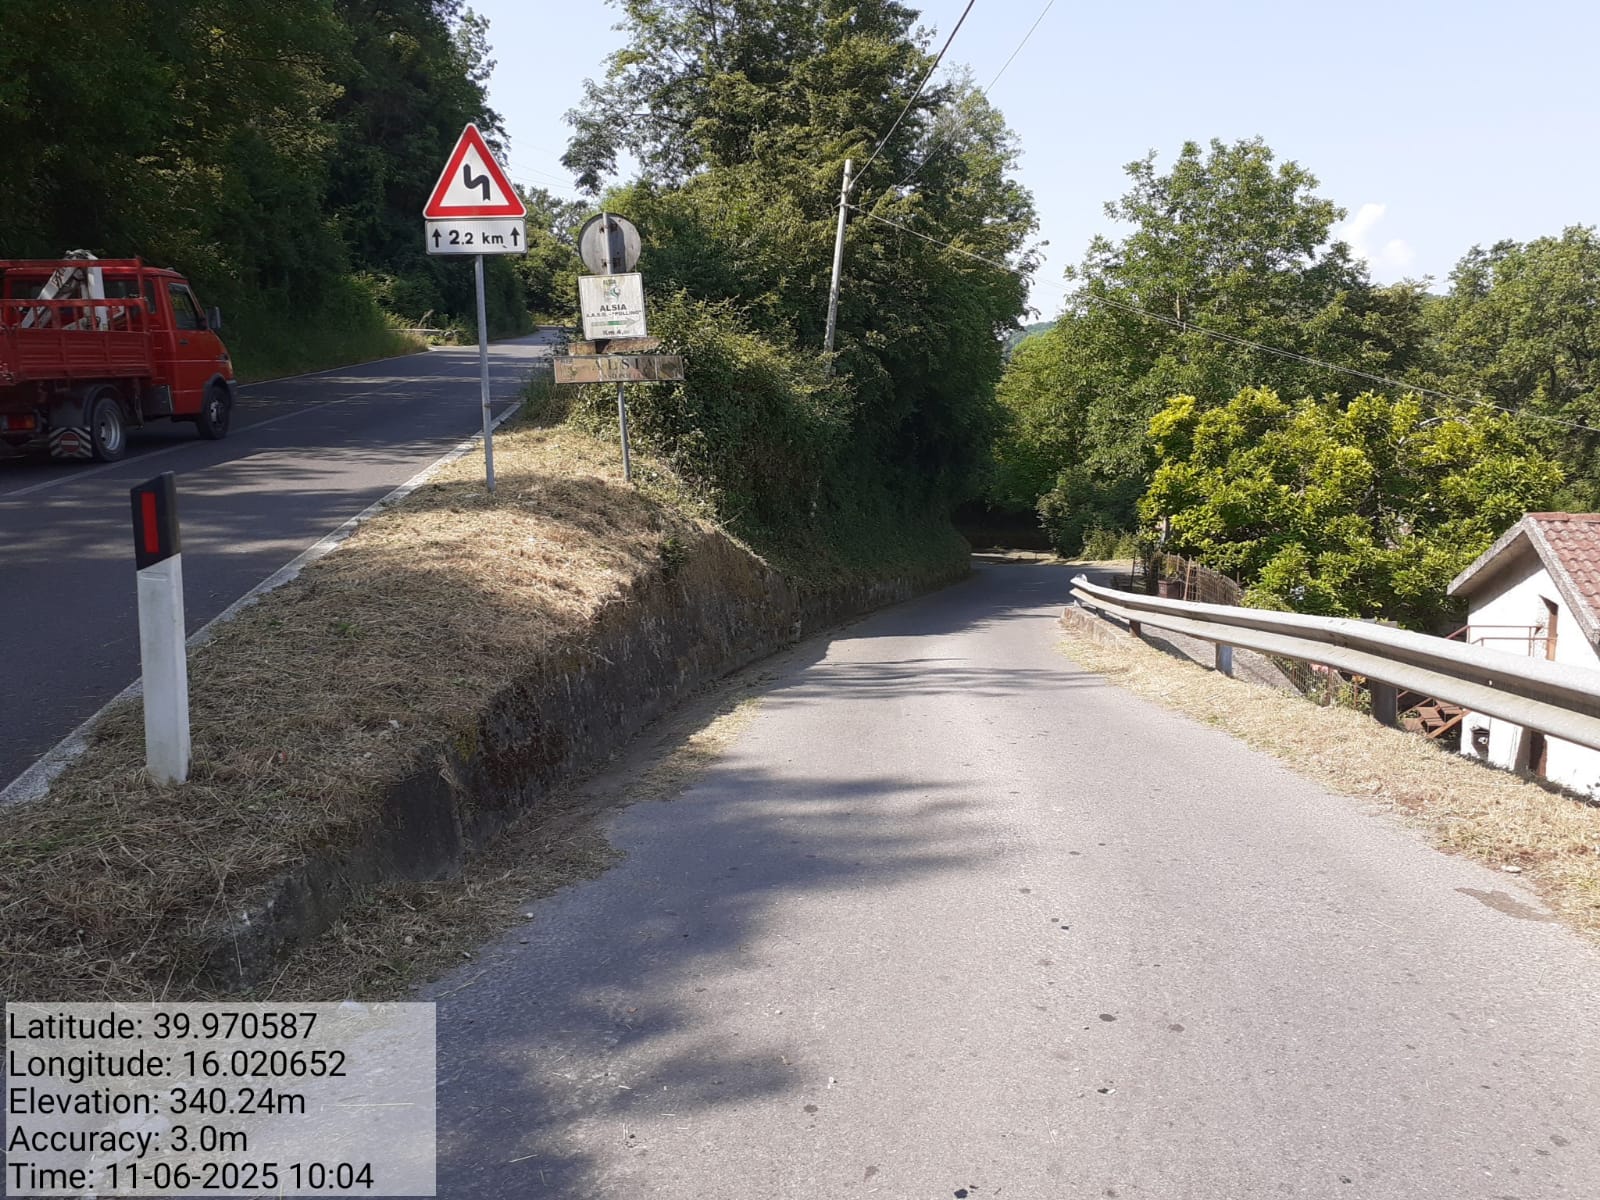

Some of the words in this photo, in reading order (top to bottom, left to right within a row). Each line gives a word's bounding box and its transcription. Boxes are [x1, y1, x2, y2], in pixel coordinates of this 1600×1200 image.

[448, 229, 474, 246] 2.2
[481, 231, 504, 245] km
[600, 304, 627, 312] ALSIA
